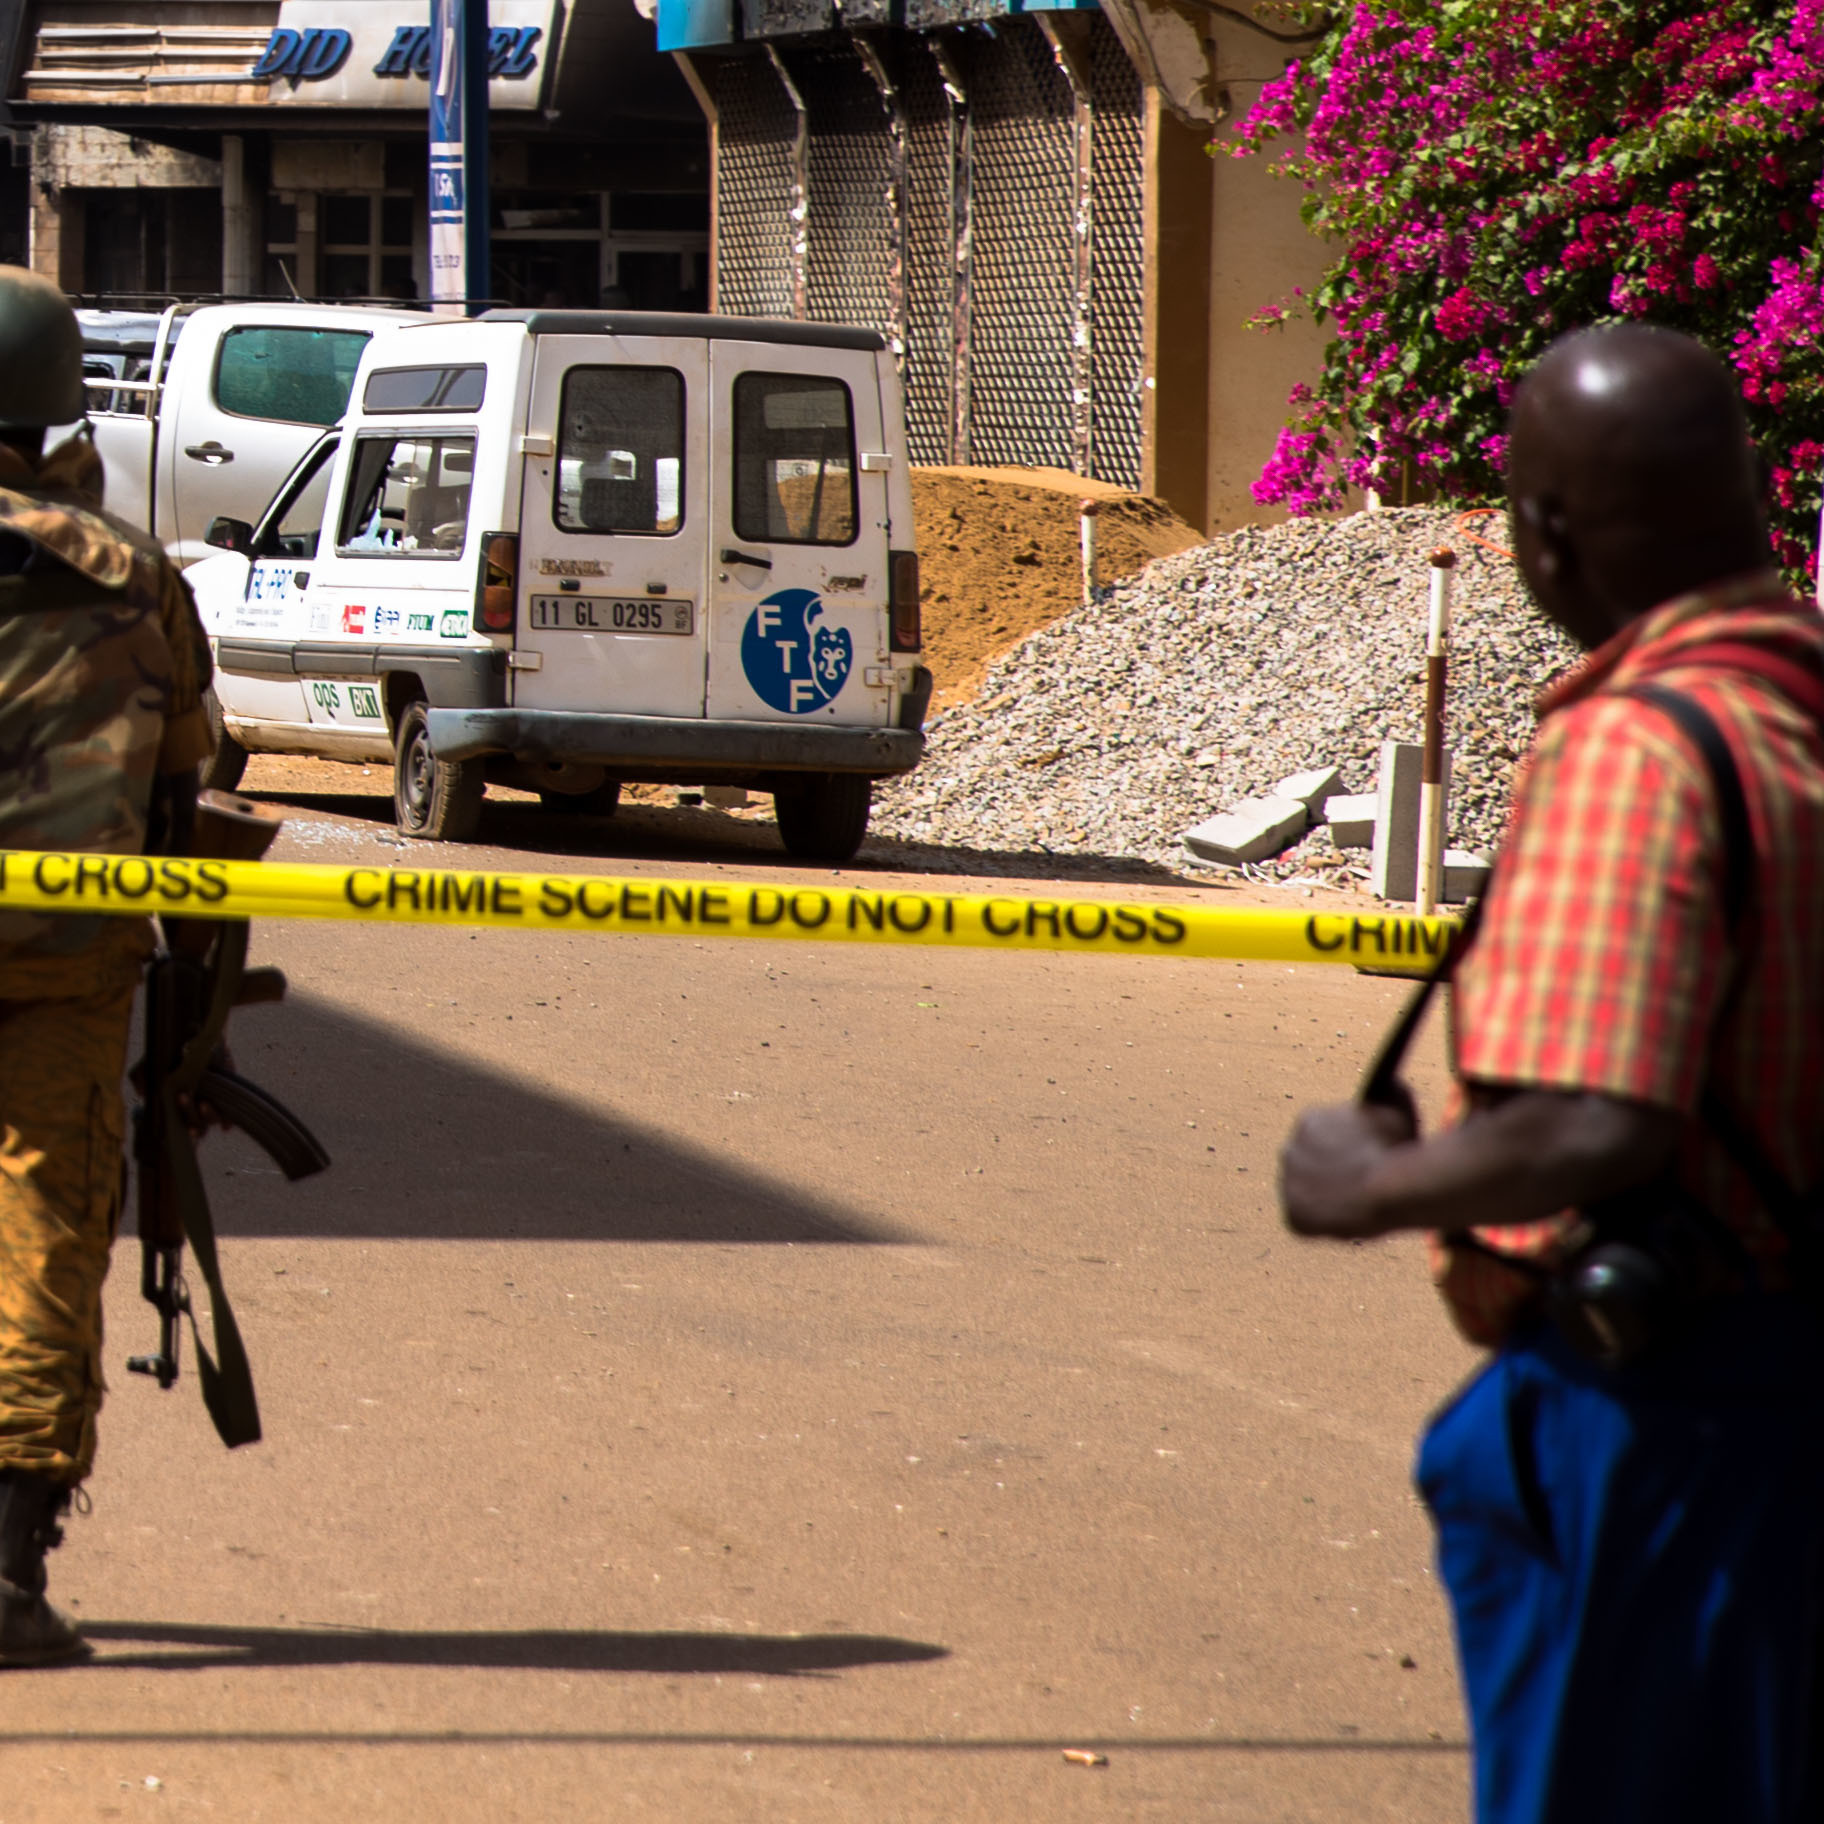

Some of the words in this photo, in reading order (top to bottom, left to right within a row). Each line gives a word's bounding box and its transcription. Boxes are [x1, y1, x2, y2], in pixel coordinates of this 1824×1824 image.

[539, 600, 559, 625] 11
[575, 601, 598, 627] GL
[613, 603, 662, 629] 0295
[33, 853, 229, 903] CROSS
[344, 869, 524, 915] CRIME
[539, 878, 731, 924] SCENE
[748, 888, 831, 929] DO
[846, 893, 965, 935] NOT
[981, 898, 1188, 944] CROSS
